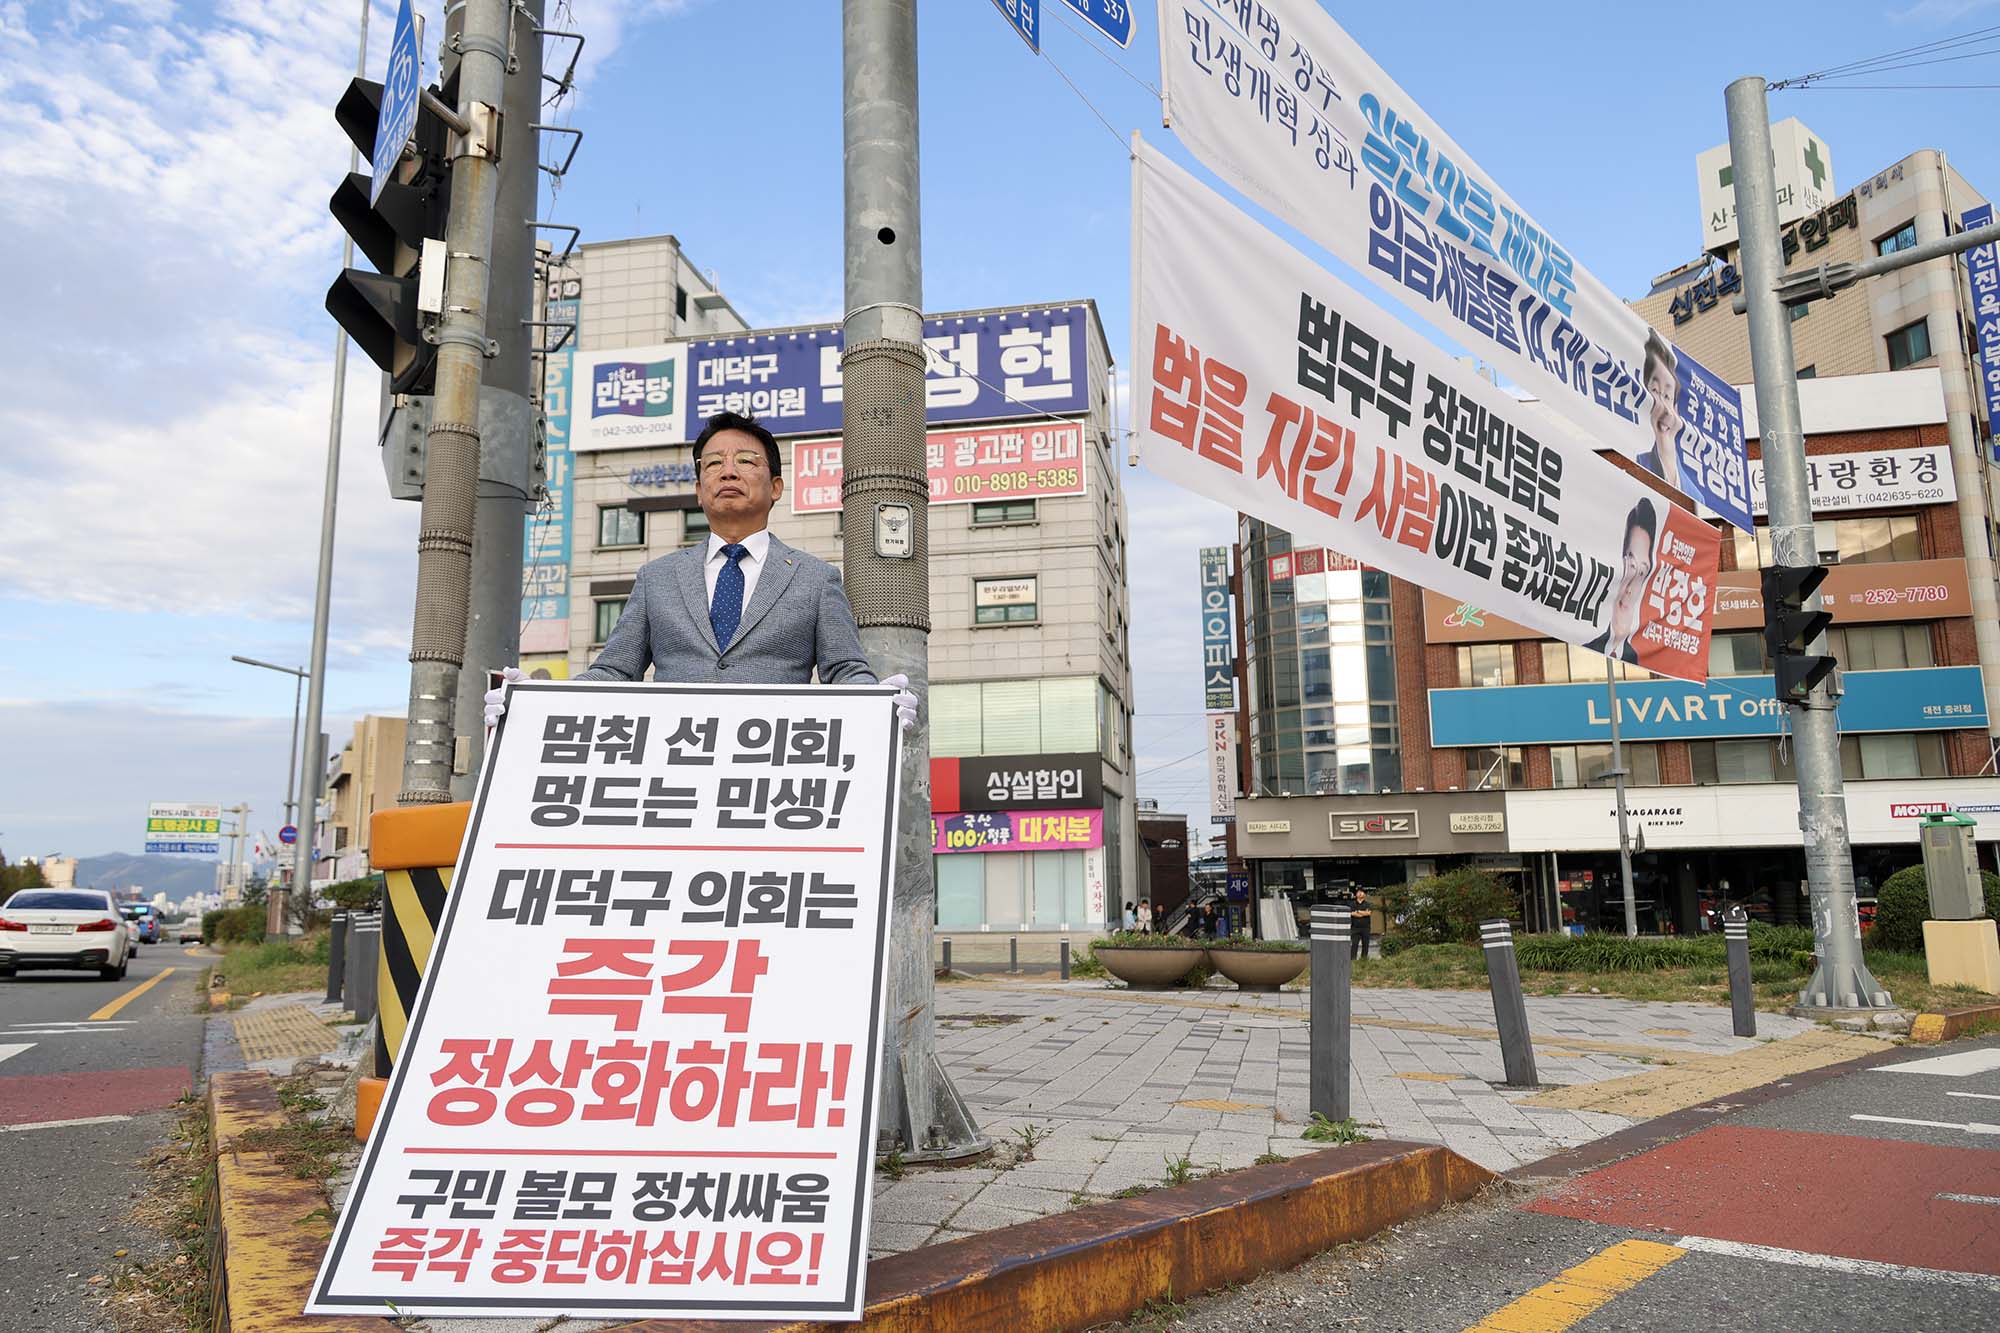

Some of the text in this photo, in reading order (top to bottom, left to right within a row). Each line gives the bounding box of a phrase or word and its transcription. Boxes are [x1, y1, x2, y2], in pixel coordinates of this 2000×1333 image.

[1006, 0, 1034, 39] 단
[1217, 0, 1280, 62] 재명
[1183, 6, 1358, 190] 민생개혁 성과
[1668, 265, 1742, 325] 신진옥
[697, 353, 779, 388] 대덕구
[596, 376, 672, 408] 민주당
[697, 387, 806, 419] 국회의원
[1297, 291, 1563, 526] 법무부 장관만큼은
[602, 422, 673, 437] 042-300-2024
[799, 447, 843, 478] 사무
[954, 433, 1024, 468] 광고판
[1031, 429, 1078, 462] 임대
[1680, 415, 1748, 514] 박정현
[953, 468, 1078, 495] 010-8918-5385
[1150, 322, 1615, 628] 법을 지킨 사람이면 좋겠습니다
[1719, 599, 1759, 610] 전세버스
[1865, 585, 1948, 604] 252-7780
[1202, 564, 1231, 693] 네오오피스
[1664, 626, 1700, 655] 당협위원장
[1587, 694, 1732, 725] LIVART
[1923, 703, 1973, 715] 대전 중리점
[540, 714, 856, 773] 멈춰 선 의회,
[529, 774, 851, 830] 멍드는 민생!
[986, 768, 1084, 802] 상설할인
[963, 814, 992, 829] 국산
[1019, 815, 1092, 843] 대처분
[1610, 808, 1682, 817] NNAGARAGE
[1893, 804, 1947, 816] MOTUL
[485, 867, 859, 930] 대덕구 의회는
[546, 937, 770, 1034] 즉각
[426, 1038, 853, 1129] 정상화하라!
[396, 1168, 831, 1225] 구민 볼모 정치싸움
[371, 1226, 825, 1287] 즉각 중단하십시오!
